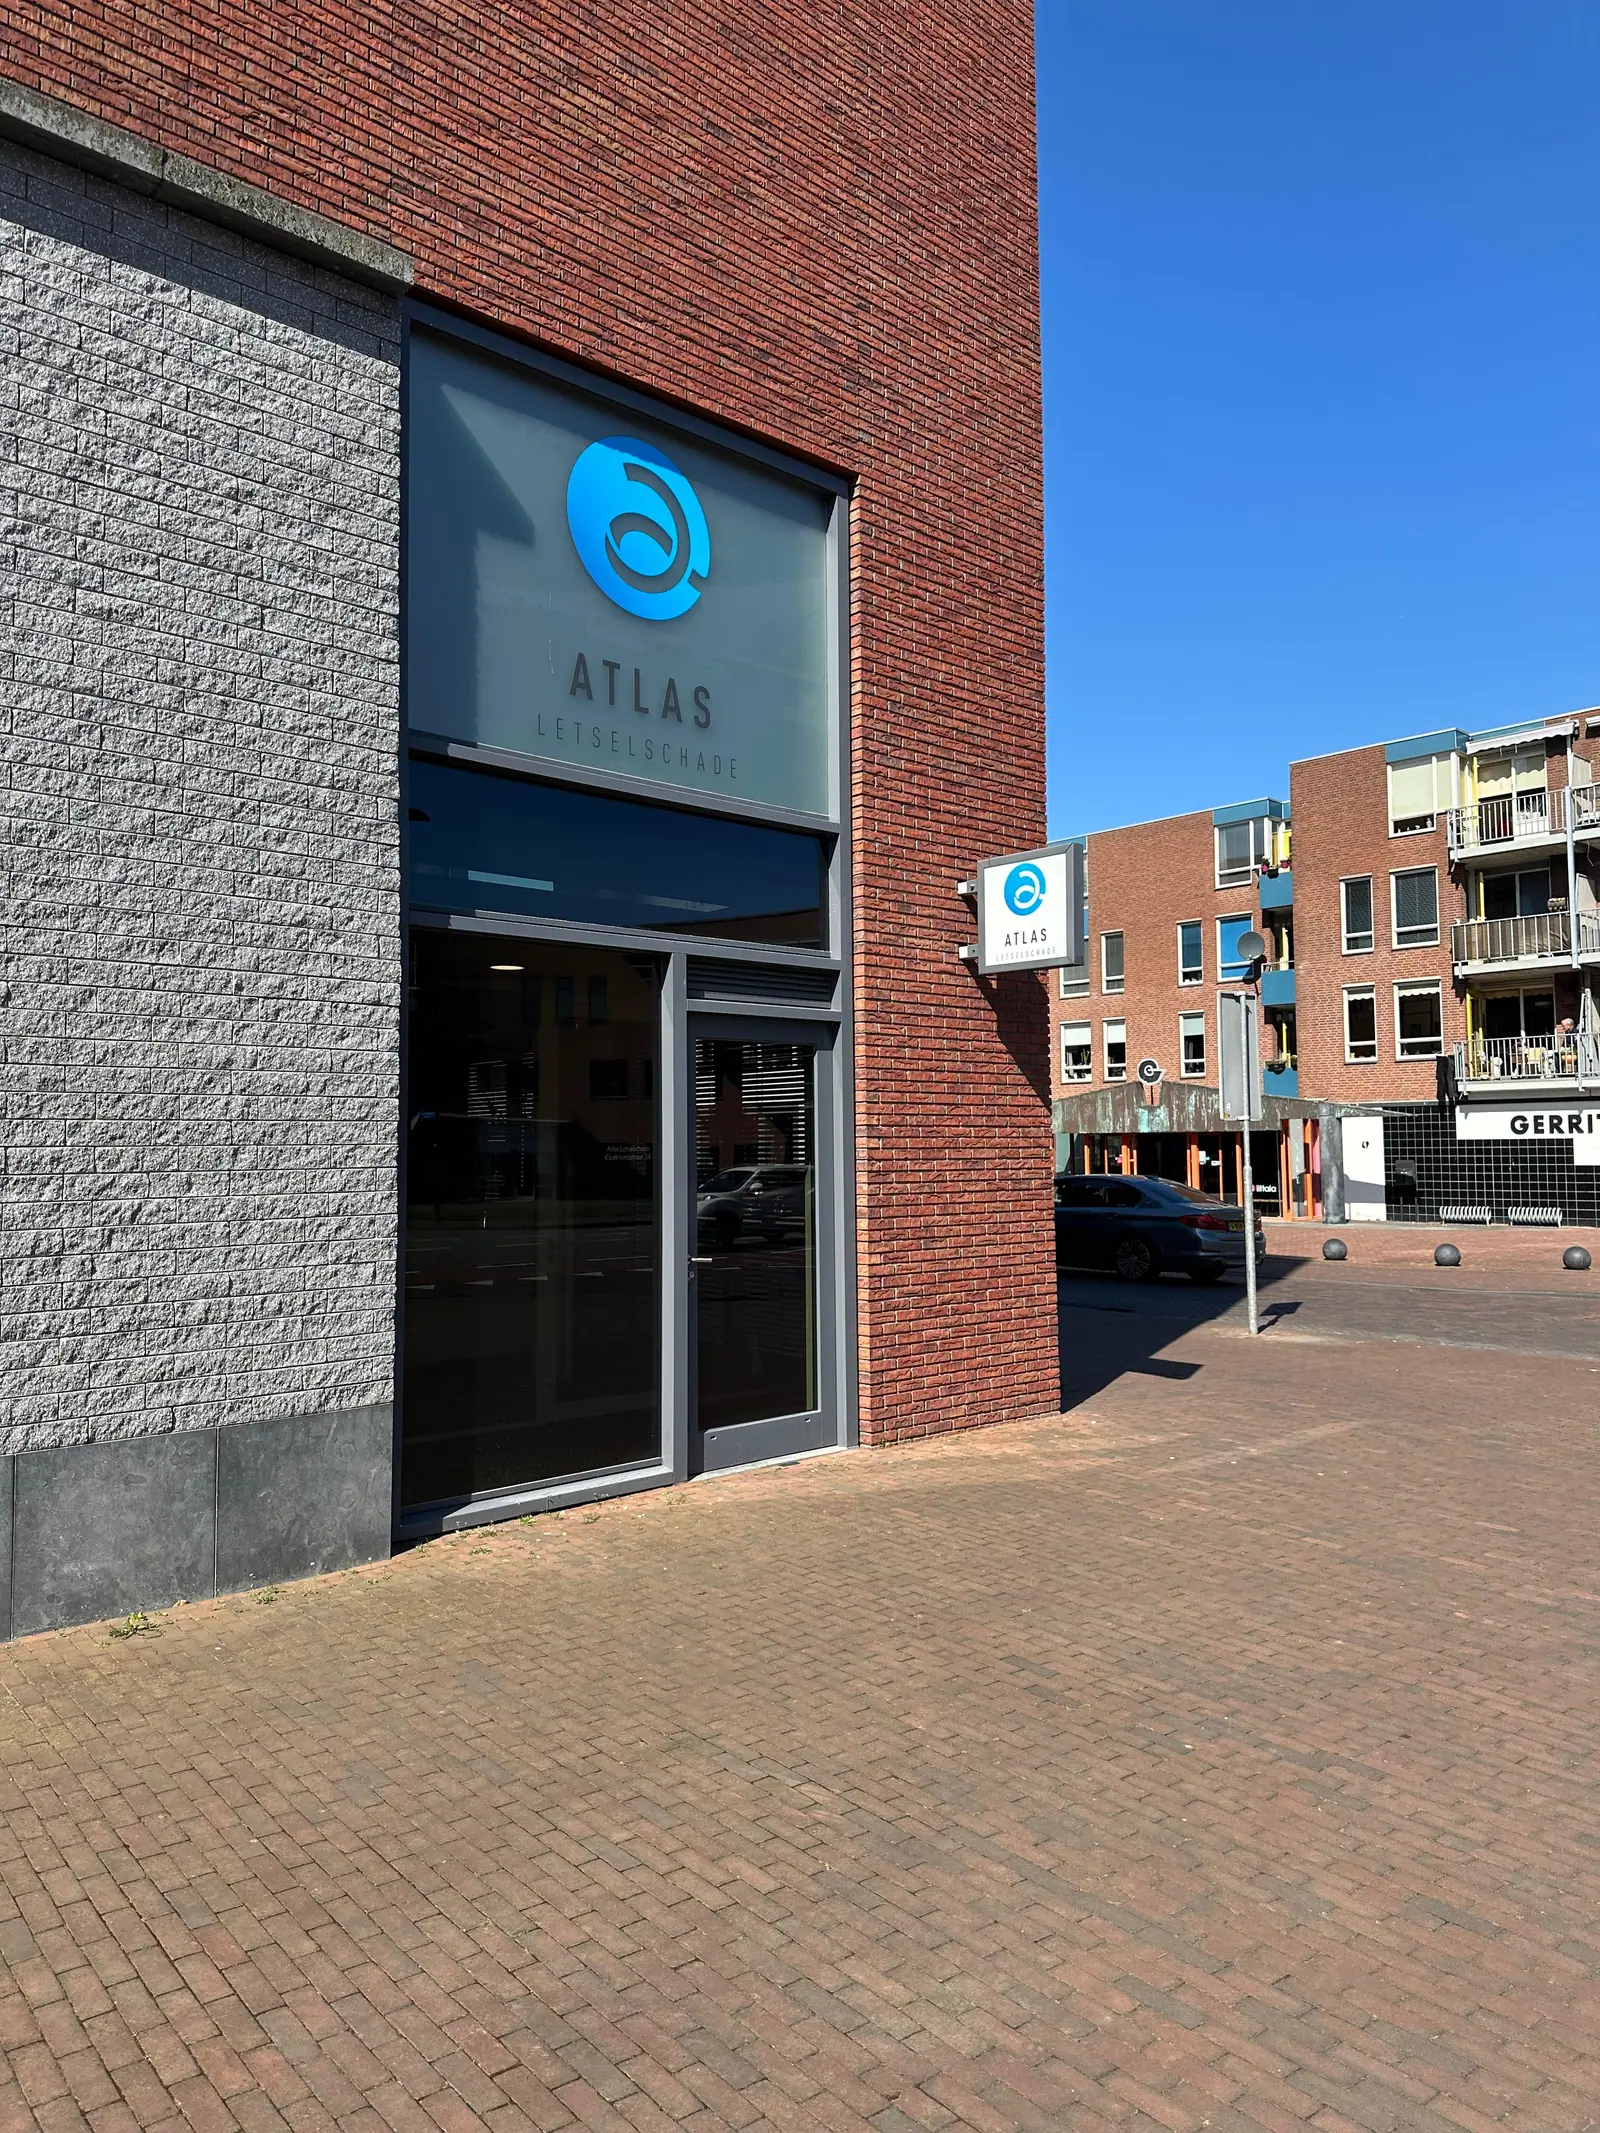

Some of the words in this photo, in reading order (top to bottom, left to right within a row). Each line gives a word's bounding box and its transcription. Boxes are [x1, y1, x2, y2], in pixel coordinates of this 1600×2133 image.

[569, 652, 711, 729] ATLAS
[537, 713, 737, 779] LETSELSCHADE
[996, 946, 1056, 962] LETSELSCHADE
[1005, 928, 1047, 947] ATLAS
